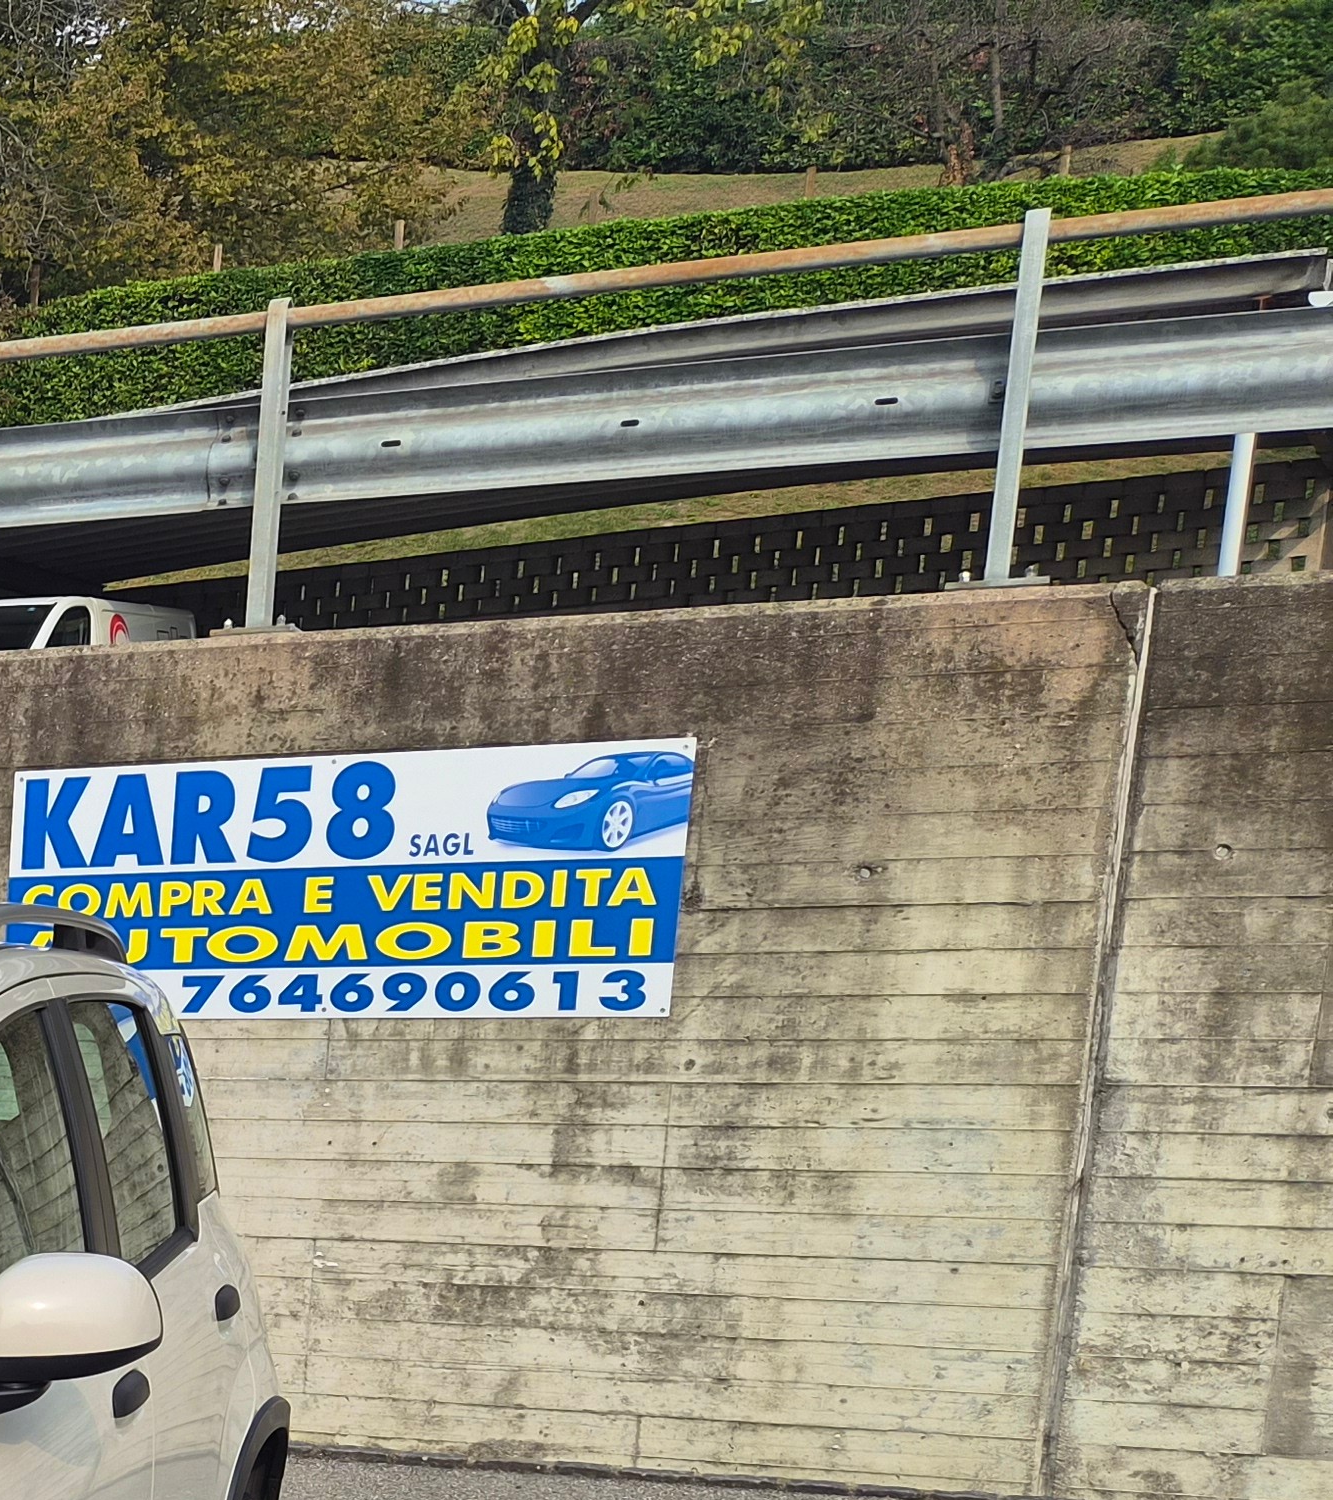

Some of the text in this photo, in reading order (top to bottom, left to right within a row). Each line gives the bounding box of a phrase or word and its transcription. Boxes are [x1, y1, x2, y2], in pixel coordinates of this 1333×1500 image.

[21, 761, 474, 870] KAR58 SAGL
[22, 867, 657, 918] COMPRA E VENDITA
[181, 970, 646, 1014] 764690613
